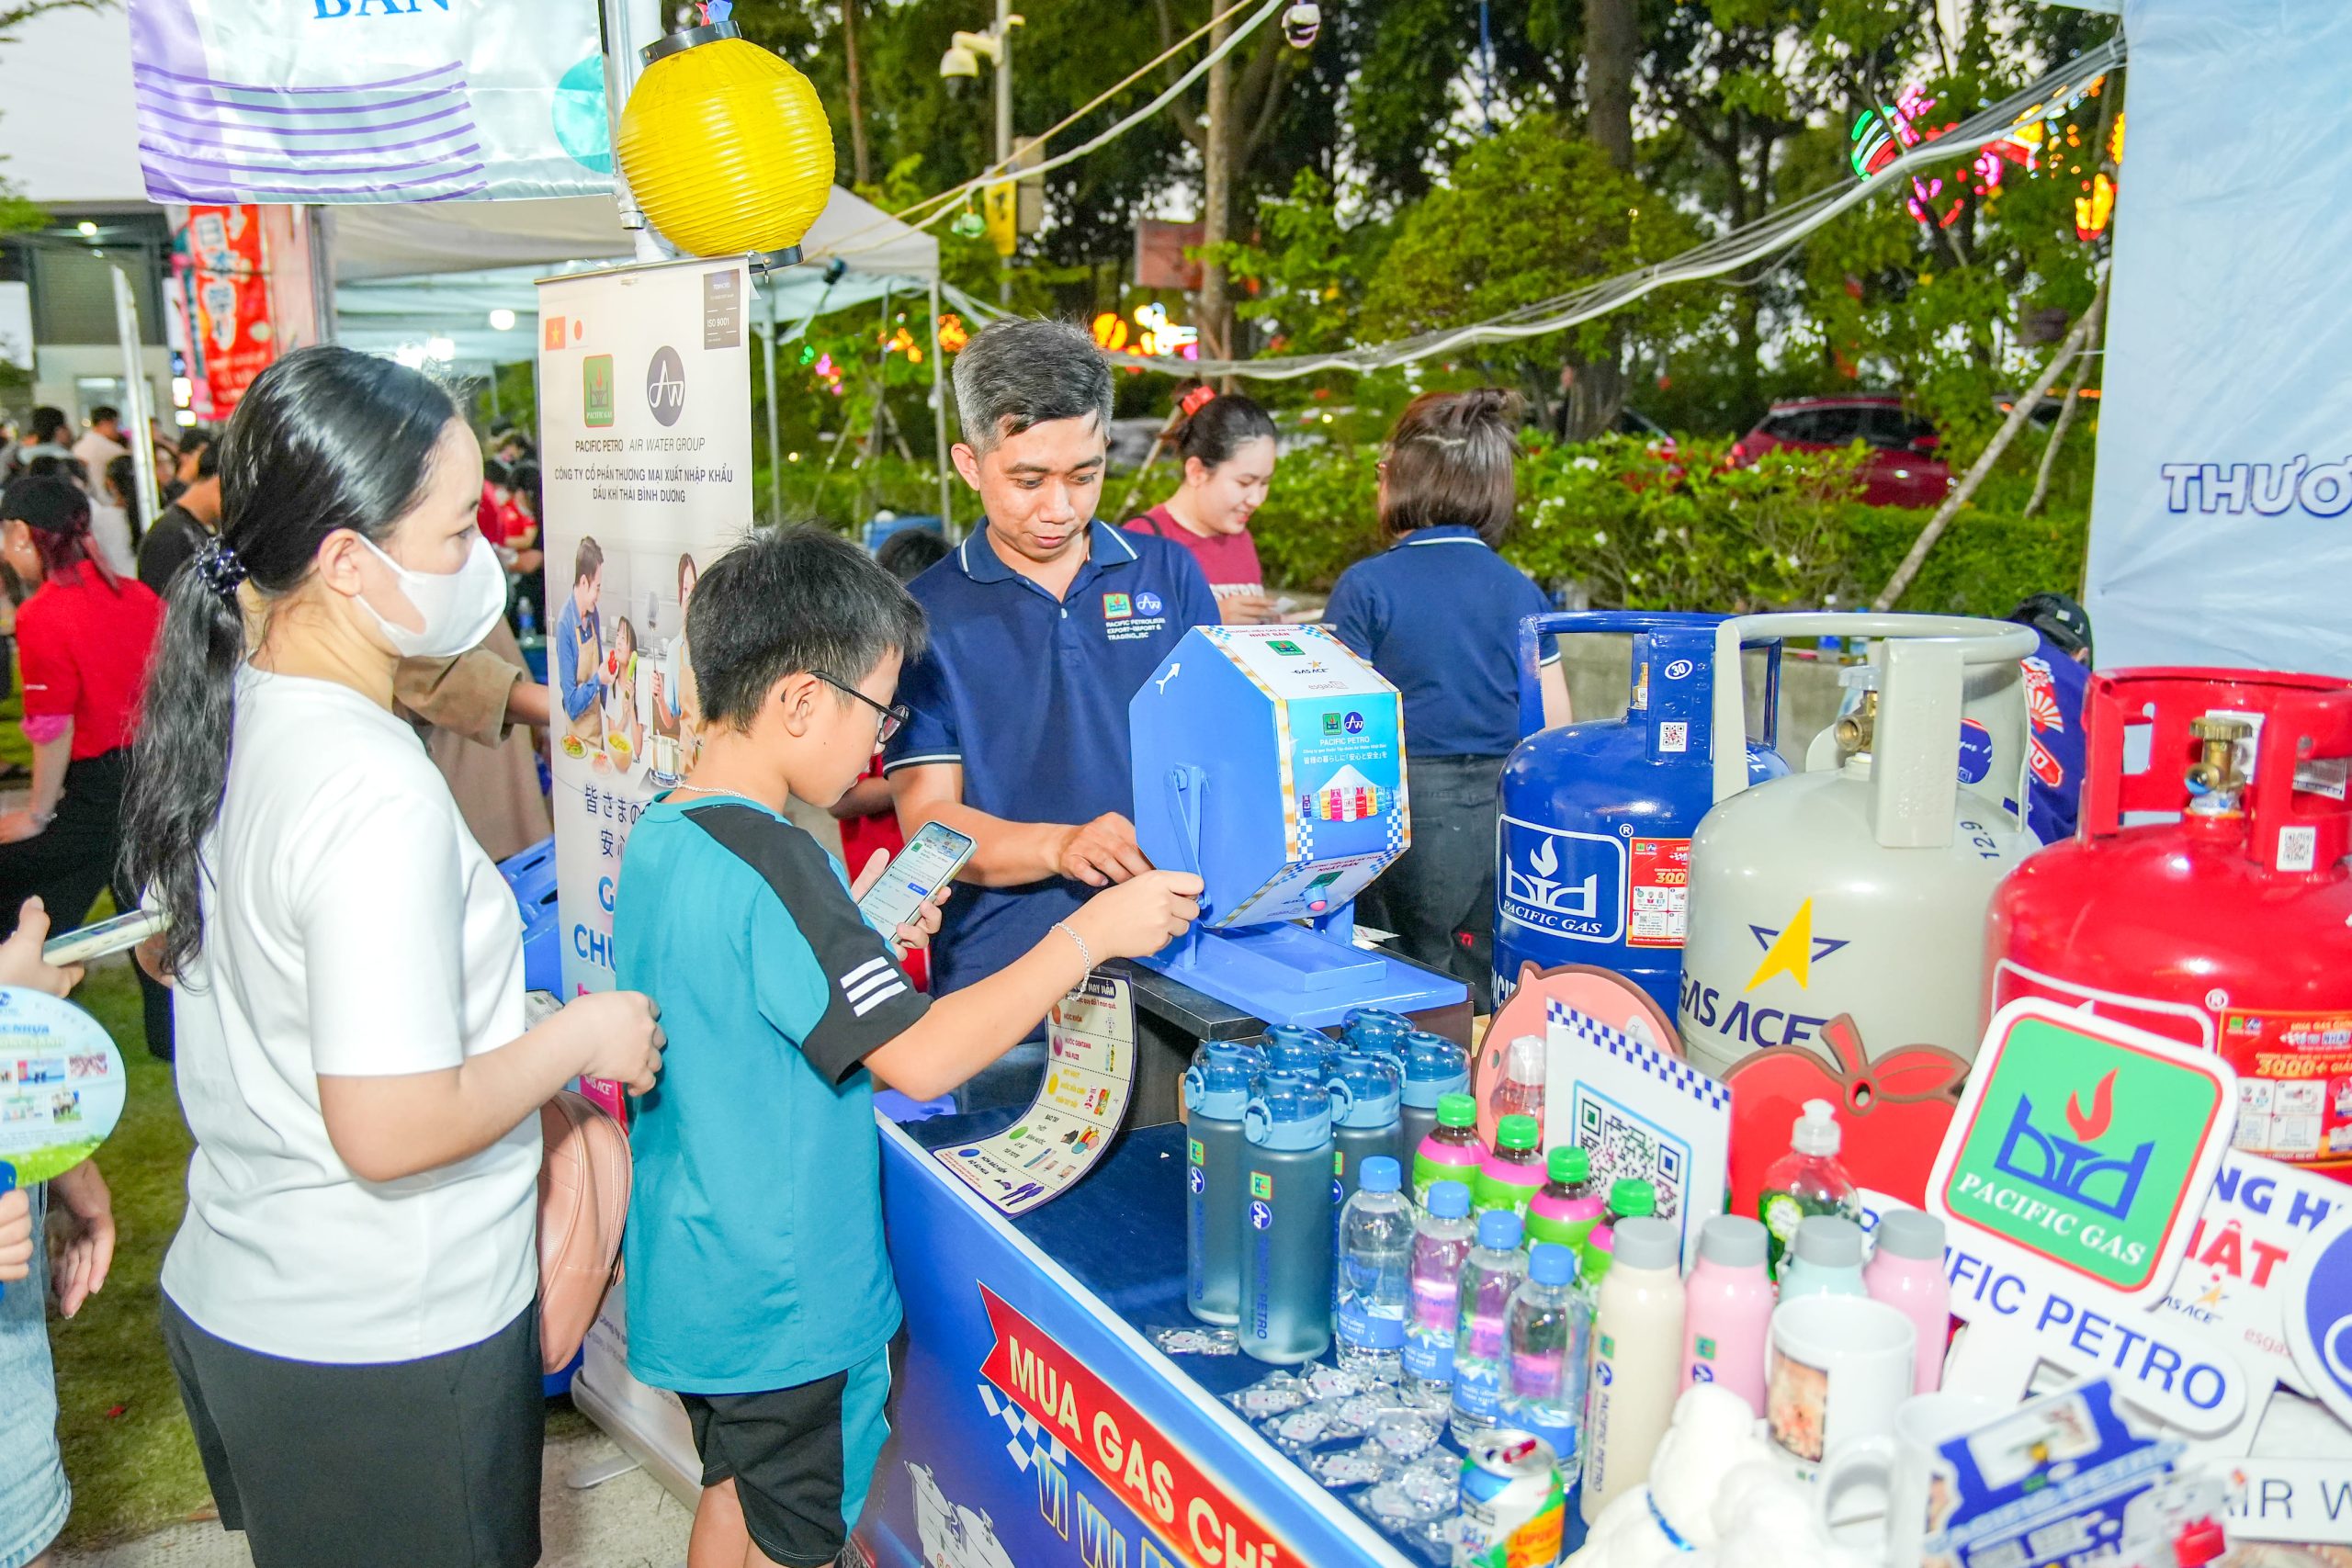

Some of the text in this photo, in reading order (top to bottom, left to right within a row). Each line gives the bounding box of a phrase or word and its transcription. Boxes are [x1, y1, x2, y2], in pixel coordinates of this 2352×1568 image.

[717, 317, 729, 327] 9001
[575, 437, 706, 453] PACIFIC PETRO AIR WATER GROUP
[574, 469, 584, 482] TY
[648, 468, 663, 484] MẠI
[637, 486, 658, 502] BÌNH
[1670, 662, 1687, 677] 30
[1319, 736, 1370, 747] PACIFIC PETRO
[1960, 820, 2000, 860] 12.9
[1503, 899, 1603, 935] PACIFIC GAS
[1956, 1172, 2148, 1268] PACIFIC GAS
[1257, 1293, 1269, 1340] PETRO
[2035, 1294, 2227, 1410] PETRO
[1009, 1335, 1083, 1444] MUA
[1093, 1410, 1175, 1524] GAS
